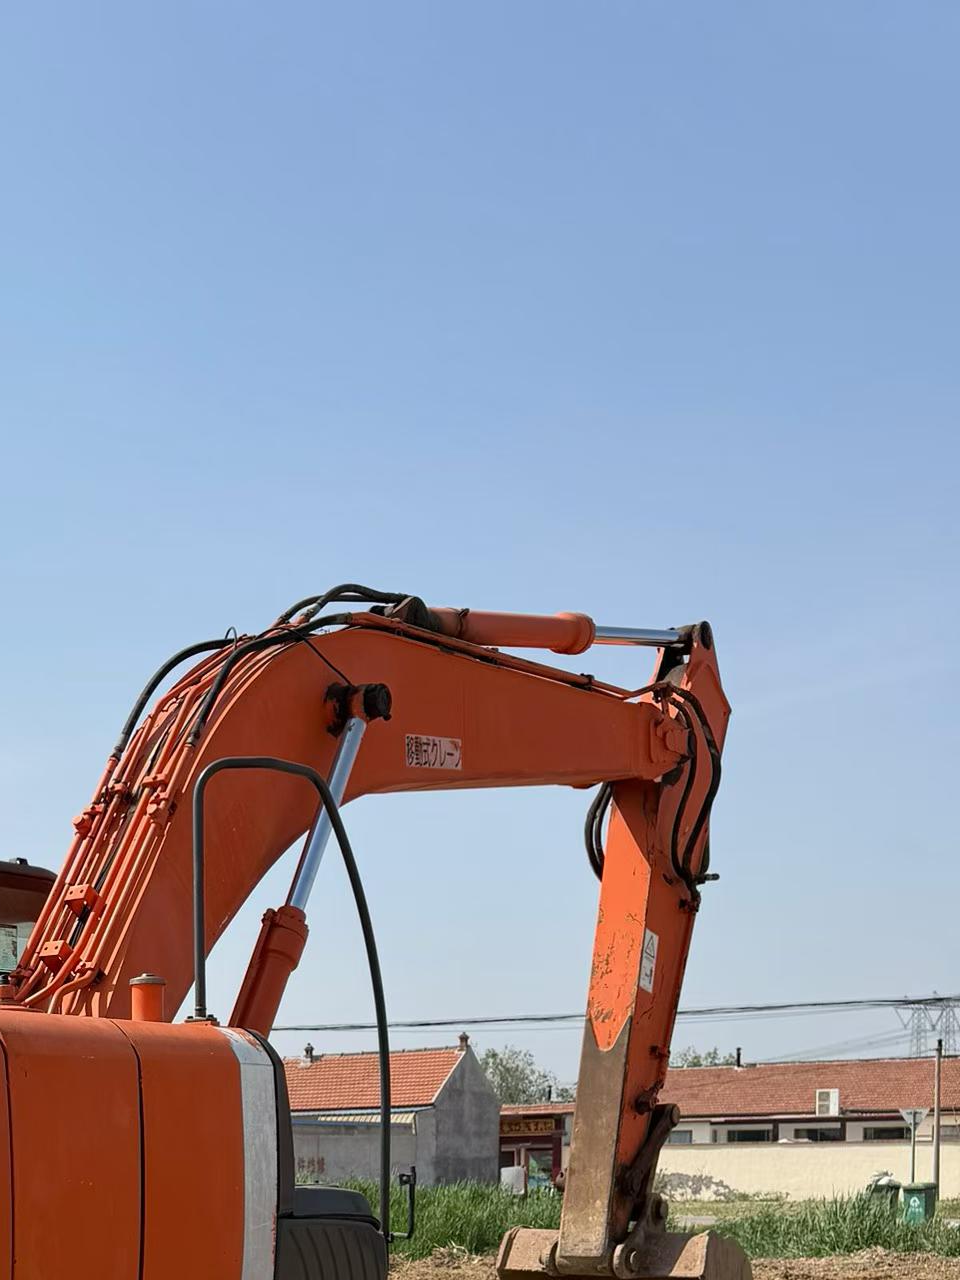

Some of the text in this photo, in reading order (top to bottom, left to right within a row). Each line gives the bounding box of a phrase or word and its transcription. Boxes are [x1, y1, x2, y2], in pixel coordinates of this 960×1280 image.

[406, 735, 460, 768] 移動式クレーン
